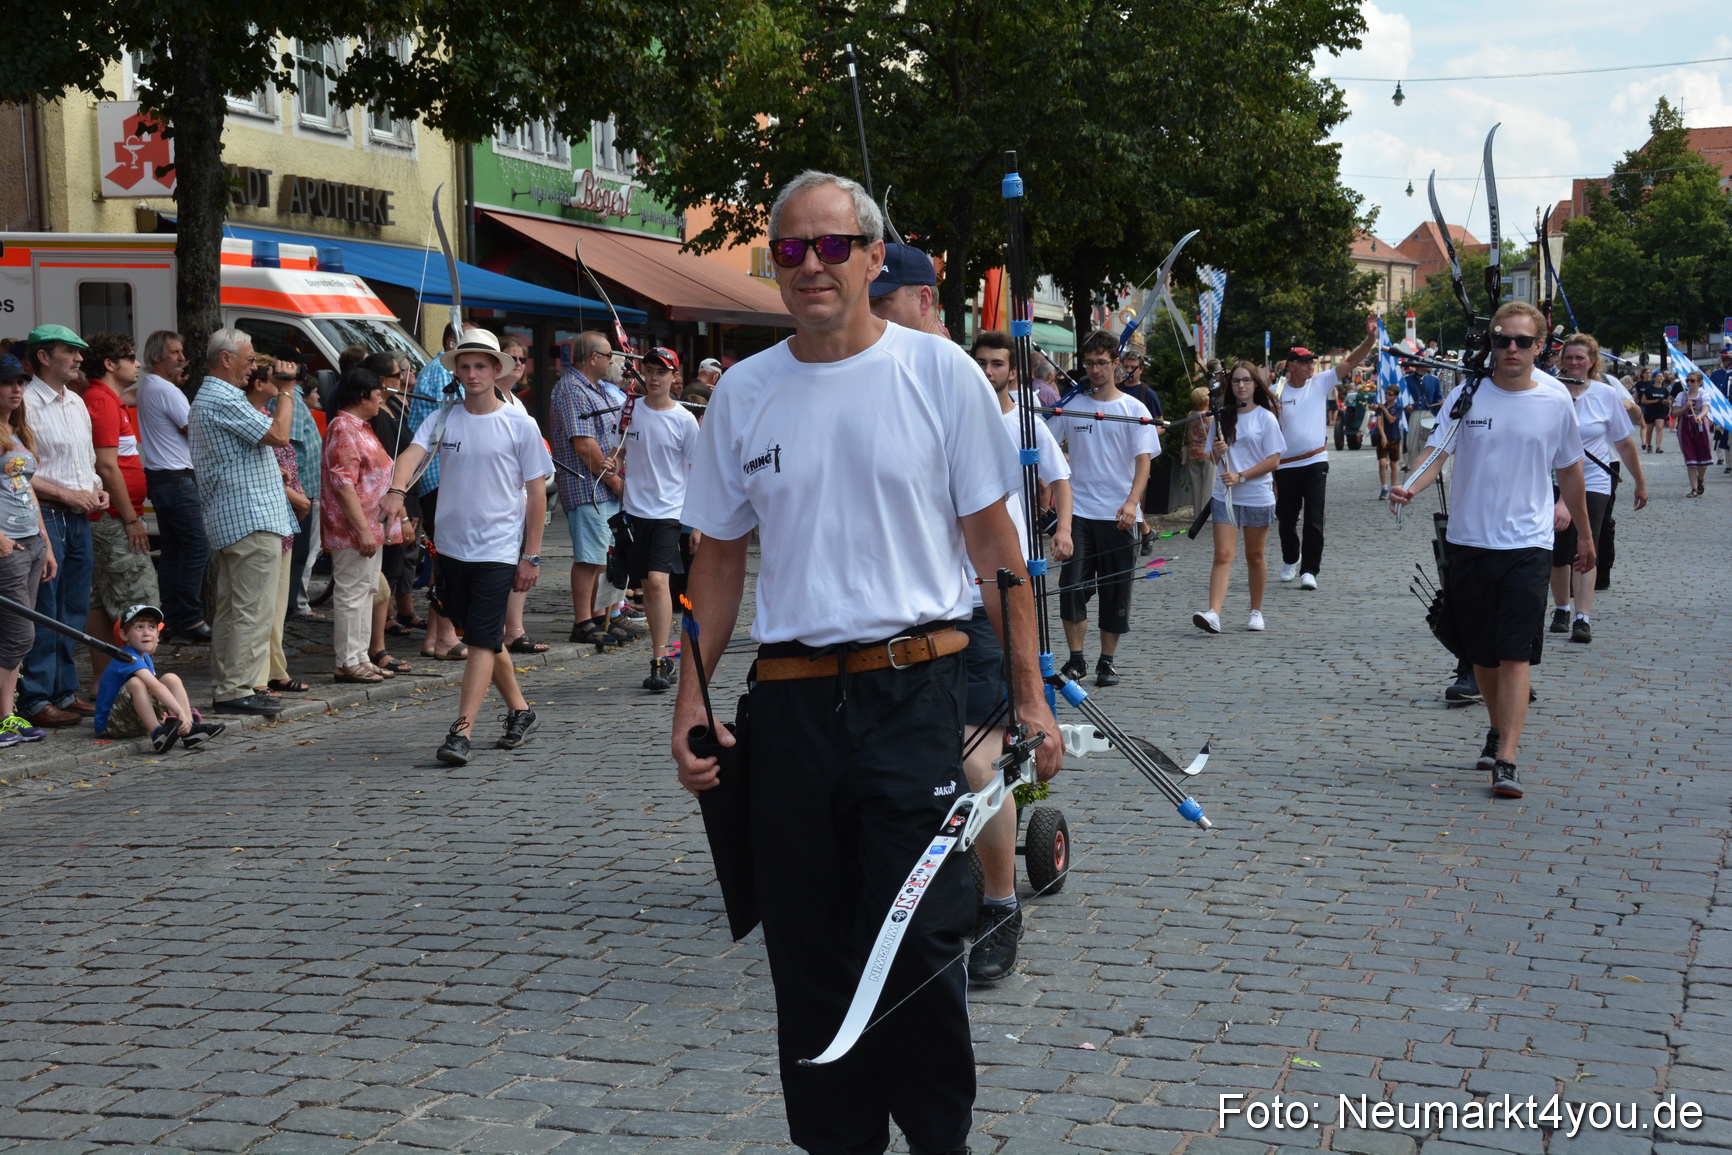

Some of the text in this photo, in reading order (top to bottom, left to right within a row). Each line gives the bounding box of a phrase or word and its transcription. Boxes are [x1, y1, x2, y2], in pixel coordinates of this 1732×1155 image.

[223, 162, 396, 226] ADT APOTHEKE
[572, 168, 633, 220] Bögerl
[1489, 203, 1498, 243] HOYT
[759, 247, 775, 279] LE
[0, 298, 15, 313] s
[934, 784, 954, 796] JAKO
[868, 924, 901, 983] WIN&WIN
